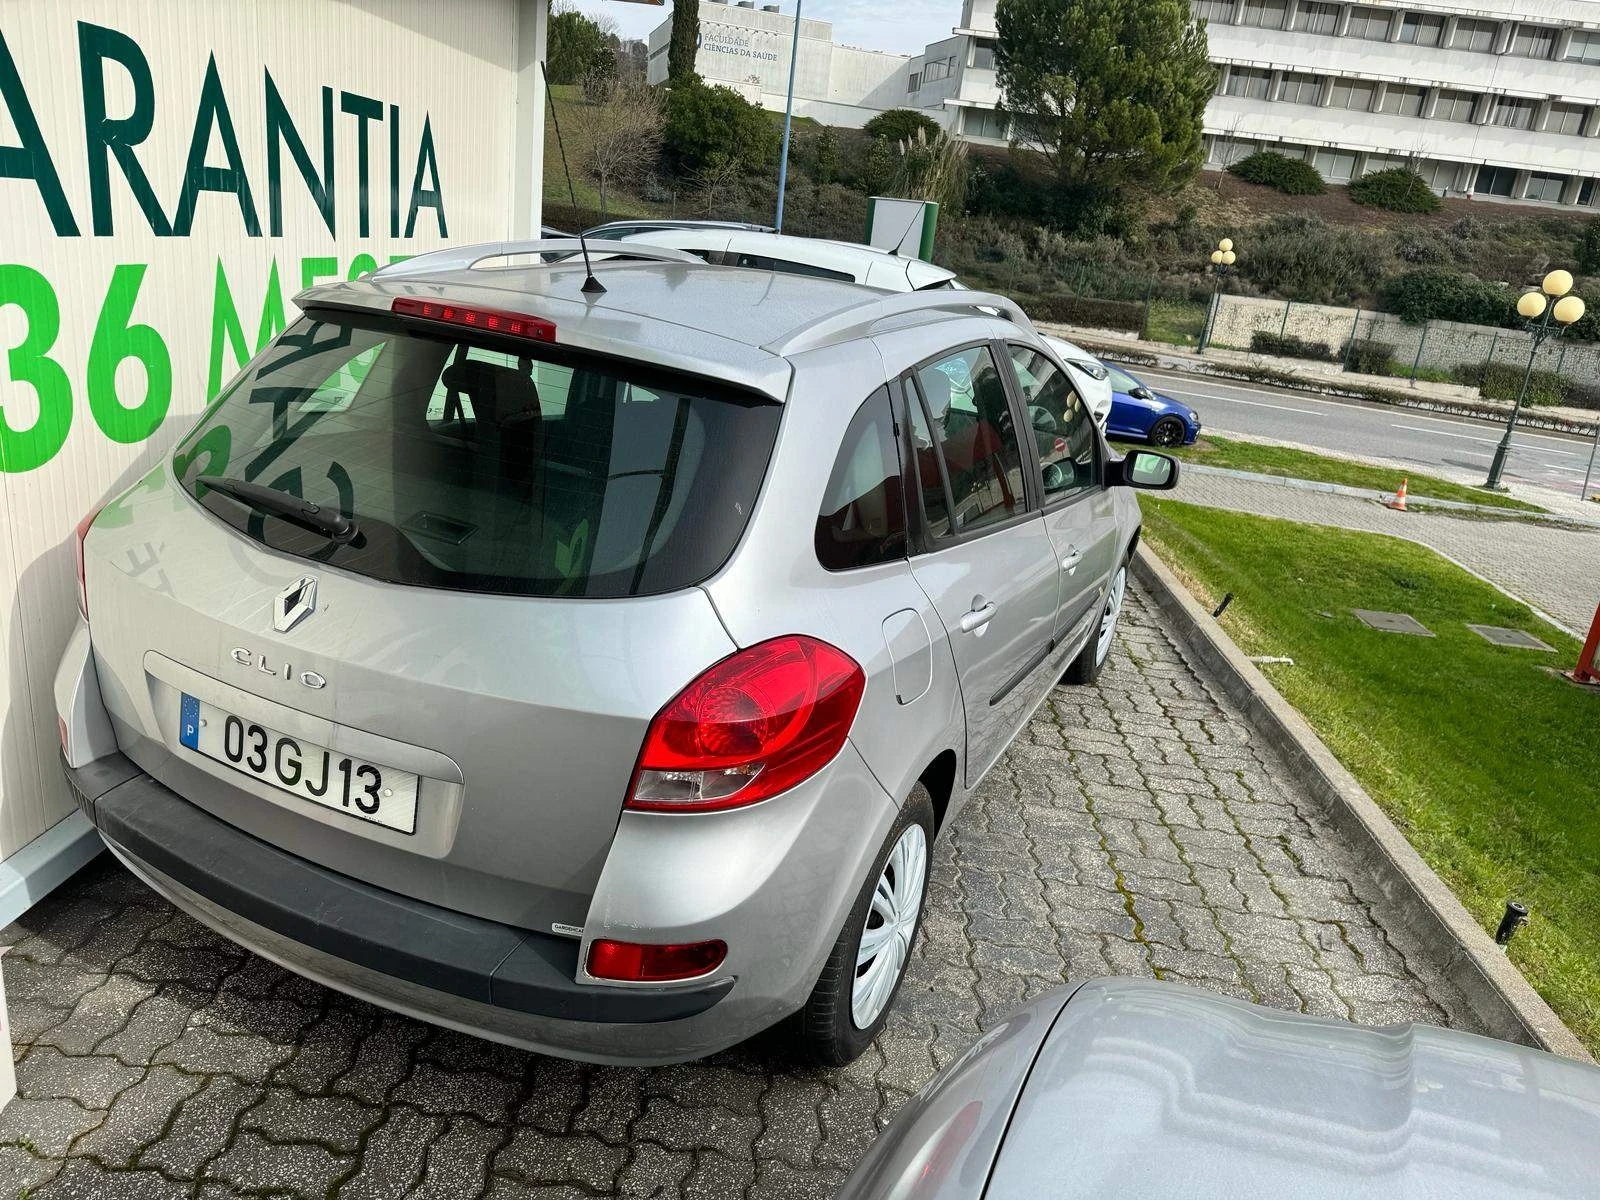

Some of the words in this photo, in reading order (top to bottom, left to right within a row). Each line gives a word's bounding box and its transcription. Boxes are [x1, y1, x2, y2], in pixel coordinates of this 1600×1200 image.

[703, 43, 739, 56] CIÊNCIAS
[740, 48, 751, 58] DA
[752, 51, 778, 61] SAÚDE
[704, 33, 749, 47] FACULDADE
[0, 263, 173, 473] 36
[230, 647, 326, 689] CLIO
[186, 724, 195, 737] P
[224, 714, 382, 815] 03GJ13
